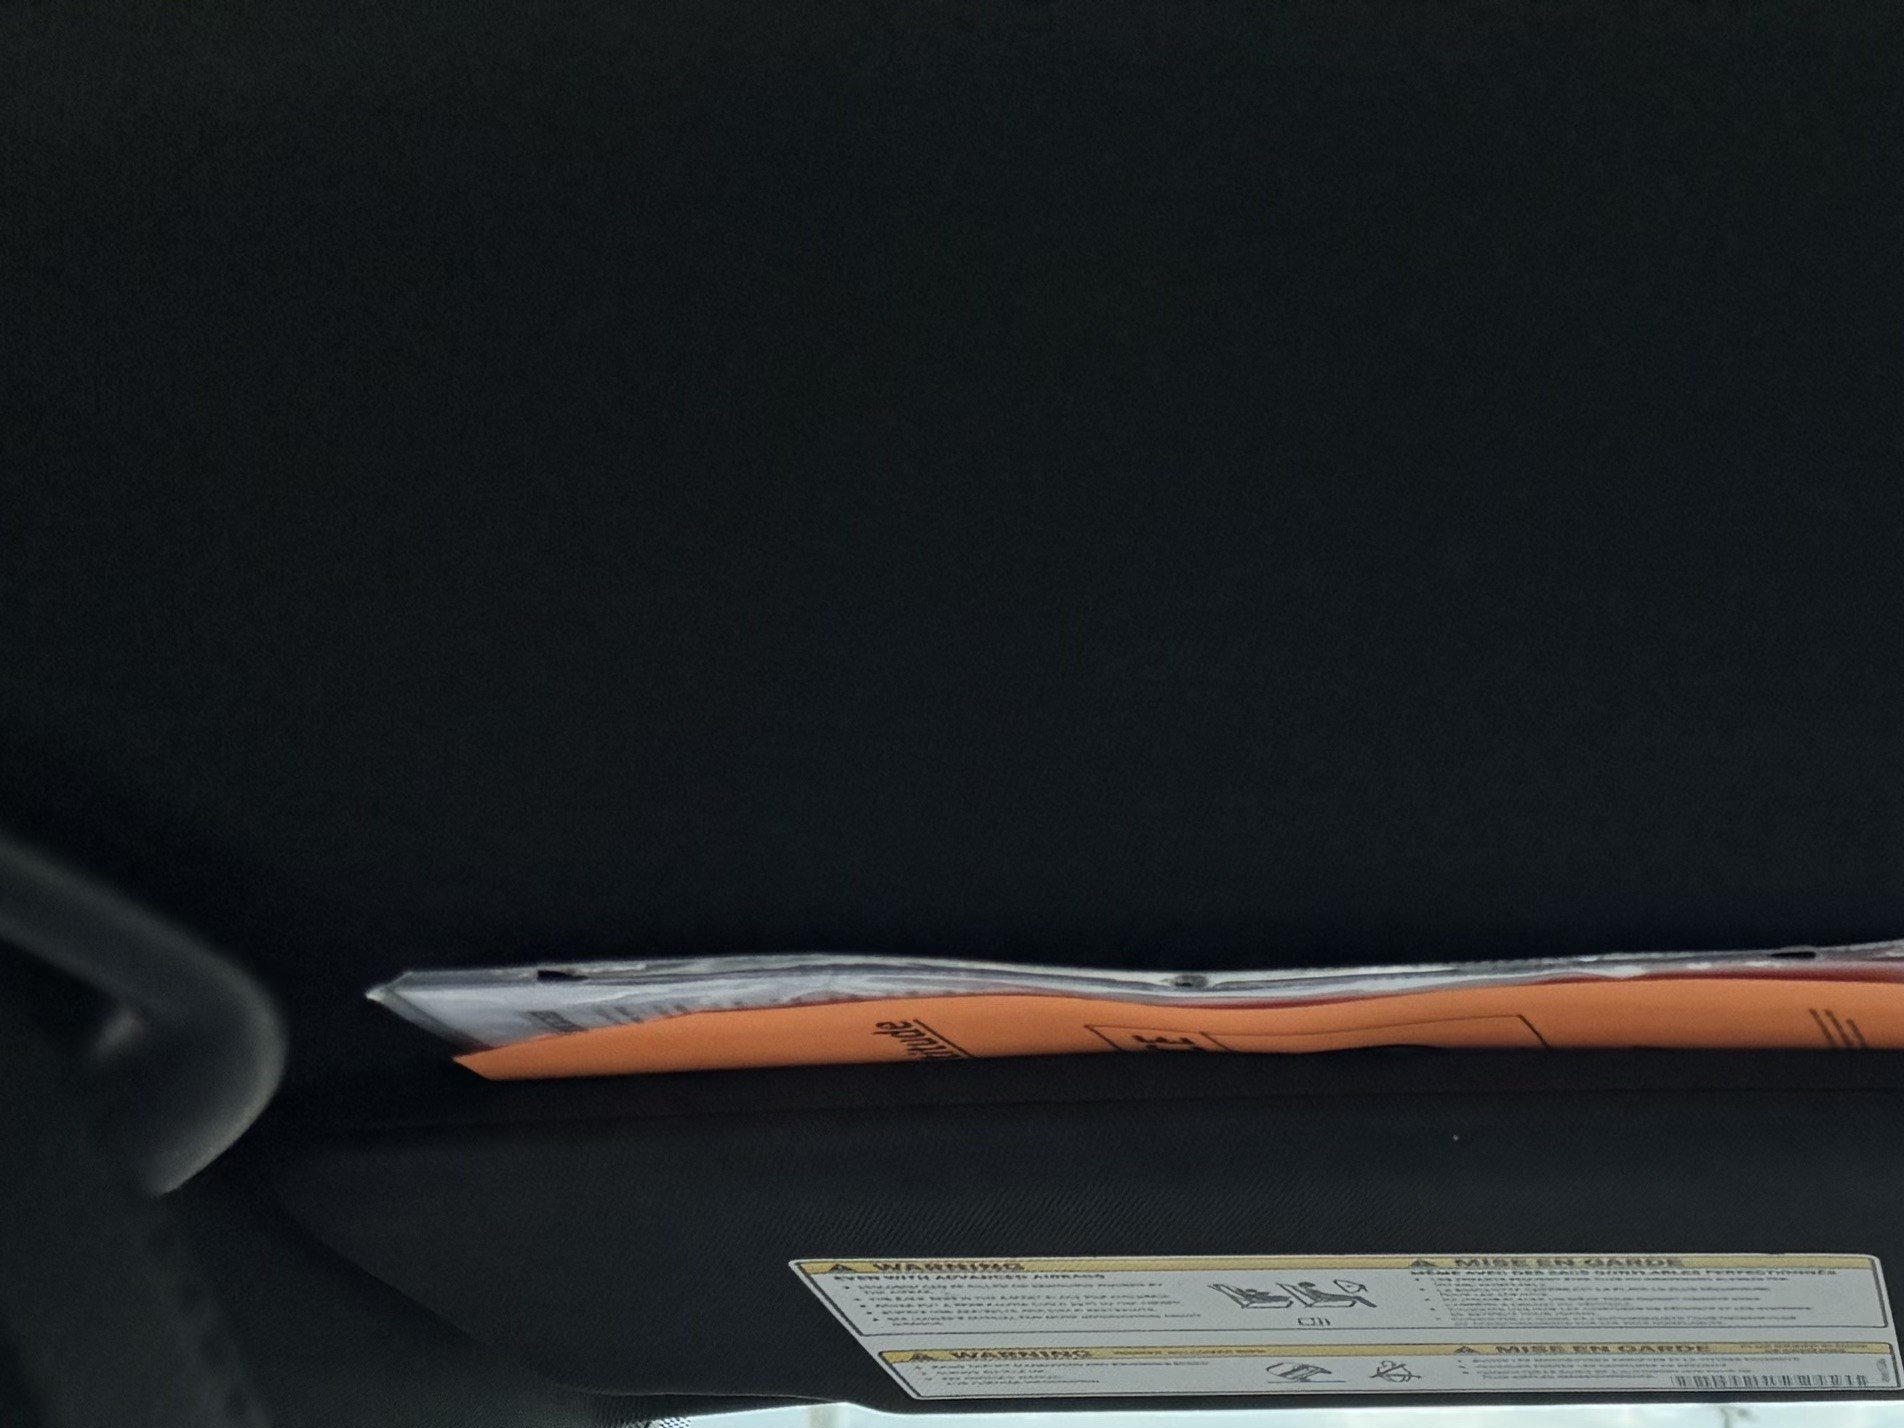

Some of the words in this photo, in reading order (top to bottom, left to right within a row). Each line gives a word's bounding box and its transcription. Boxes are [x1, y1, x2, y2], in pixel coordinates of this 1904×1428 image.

[873, 1263, 1026, 1273] WARNING
[1454, 1258, 1531, 1268] MISE
[1536, 1258, 1576, 1268] EN
[1583, 1258, 1684, 1268] GARDE
[1495, 1345, 1565, 1354] MISE
[1571, 1345, 1610, 1354] EN
[1617, 1345, 1713, 1354] GARDE
[951, 1350, 1092, 1360] WARNING
